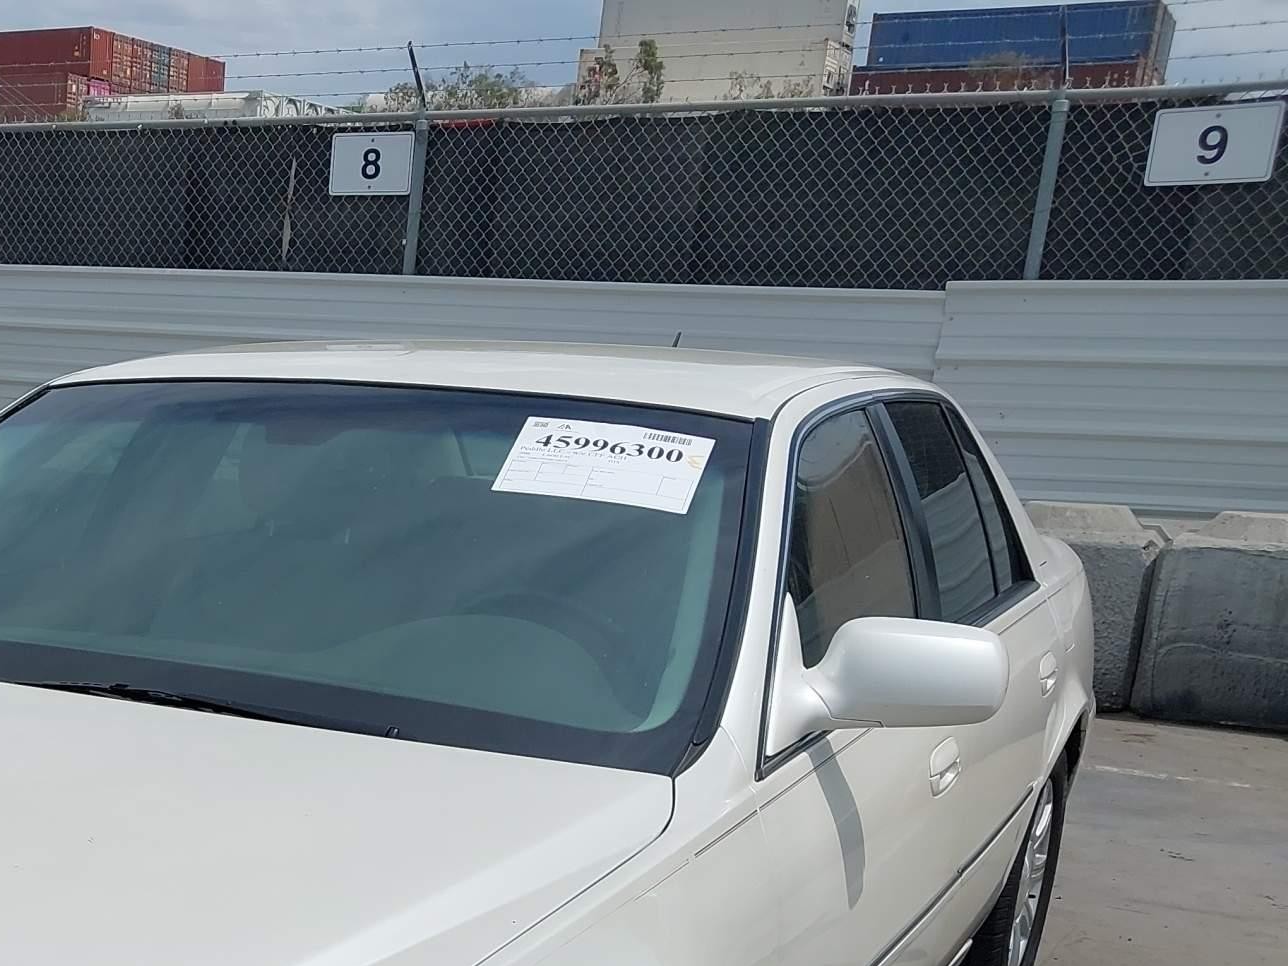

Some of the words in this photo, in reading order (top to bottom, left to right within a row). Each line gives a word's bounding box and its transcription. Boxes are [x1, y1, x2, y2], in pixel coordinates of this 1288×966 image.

[1196, 125, 1229, 165] 9
[361, 148, 381, 180] 8
[535, 434, 684, 463] 45996300
